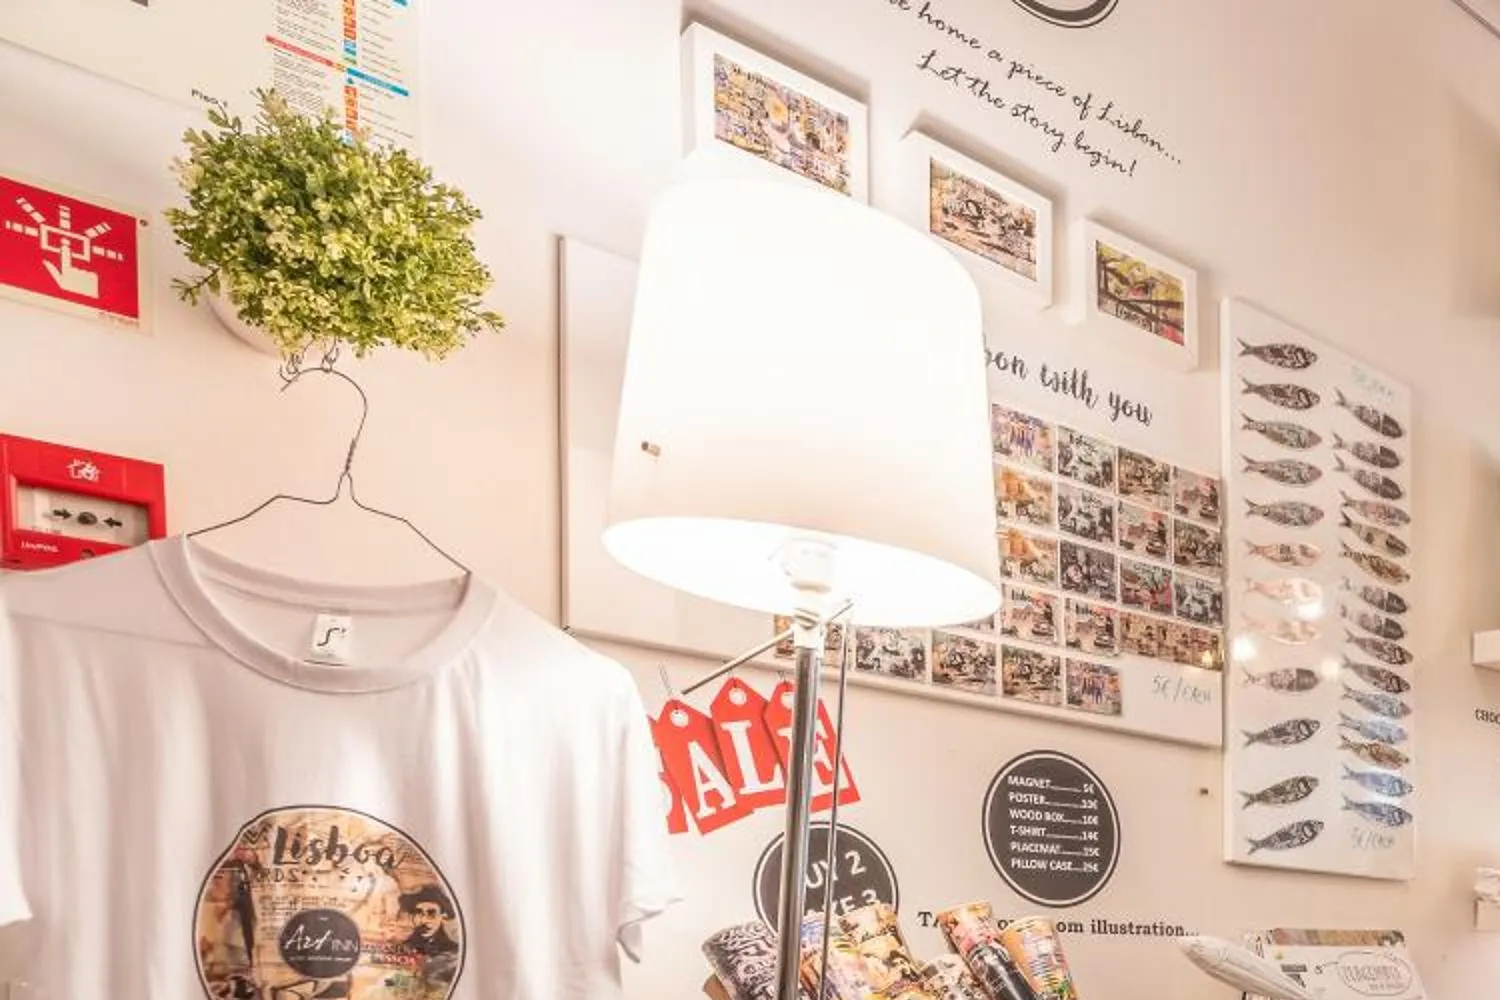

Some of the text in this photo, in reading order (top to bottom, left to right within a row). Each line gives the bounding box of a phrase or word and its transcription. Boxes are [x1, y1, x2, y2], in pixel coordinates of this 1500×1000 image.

[918, 1, 981, 49] home
[988, 49, 1002, 62] a
[1008, 60, 1066, 97] piece
[1072, 93, 1092, 120] of
[916, 50, 1137, 177] Let the story begin!
[1039, 364, 1098, 409] with
[1109, 391, 1152, 426] you
[1007, 775, 1051, 789] MAGNET
[1008, 791, 1046, 805] POSTER
[1009, 808, 1042, 822] WOOD
[1044, 811, 1064, 822] BOX
[1010, 825, 1047, 837] T-SHIRT
[273, 825, 402, 872] Lisboa
[804, 851, 866, 889] UY 2
[1011, 858, 1048, 870] PILLOW
[1050, 860, 1073, 871] CASE
